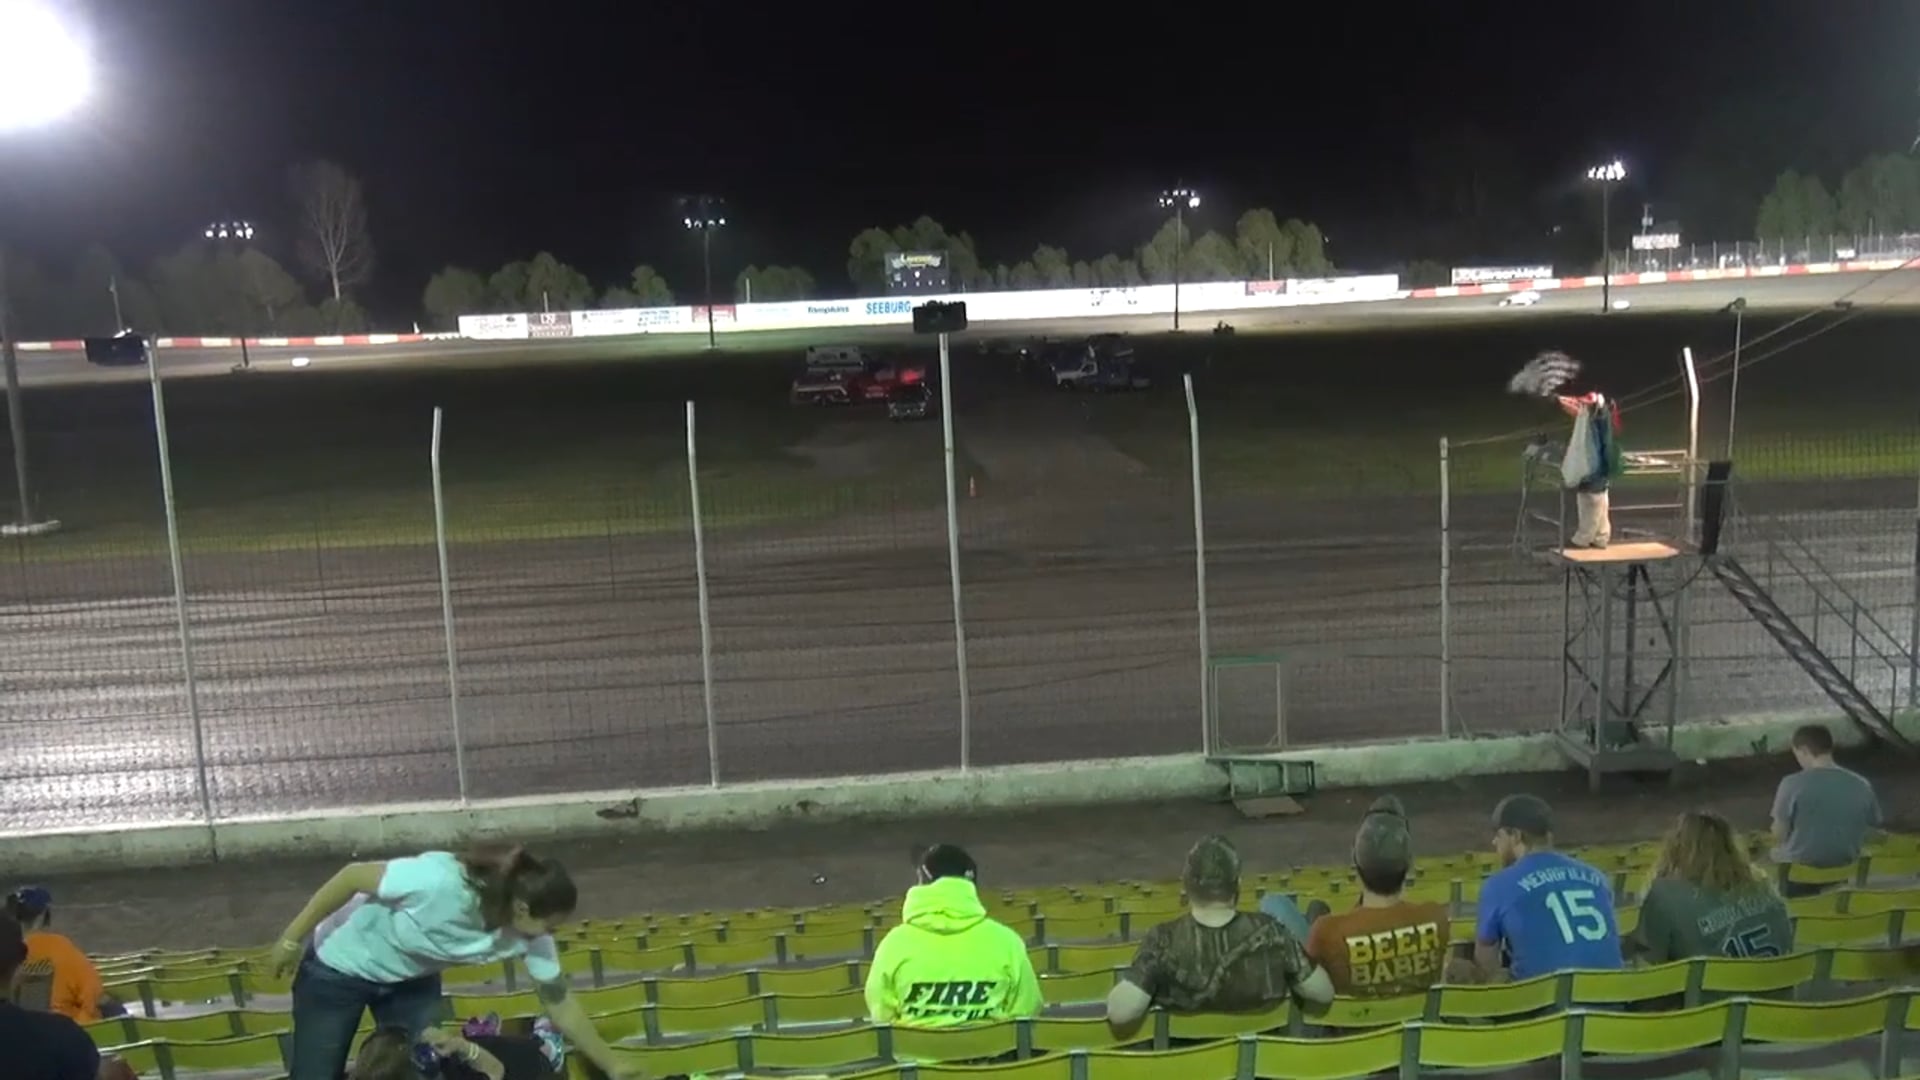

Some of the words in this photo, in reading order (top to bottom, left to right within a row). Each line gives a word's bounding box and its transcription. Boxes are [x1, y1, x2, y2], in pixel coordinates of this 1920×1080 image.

[866, 301, 911, 314] SEEBURG
[1545, 890, 1607, 945] 15
[1345, 922, 1440, 965] BEER
[904, 980, 997, 1006] FIRE
